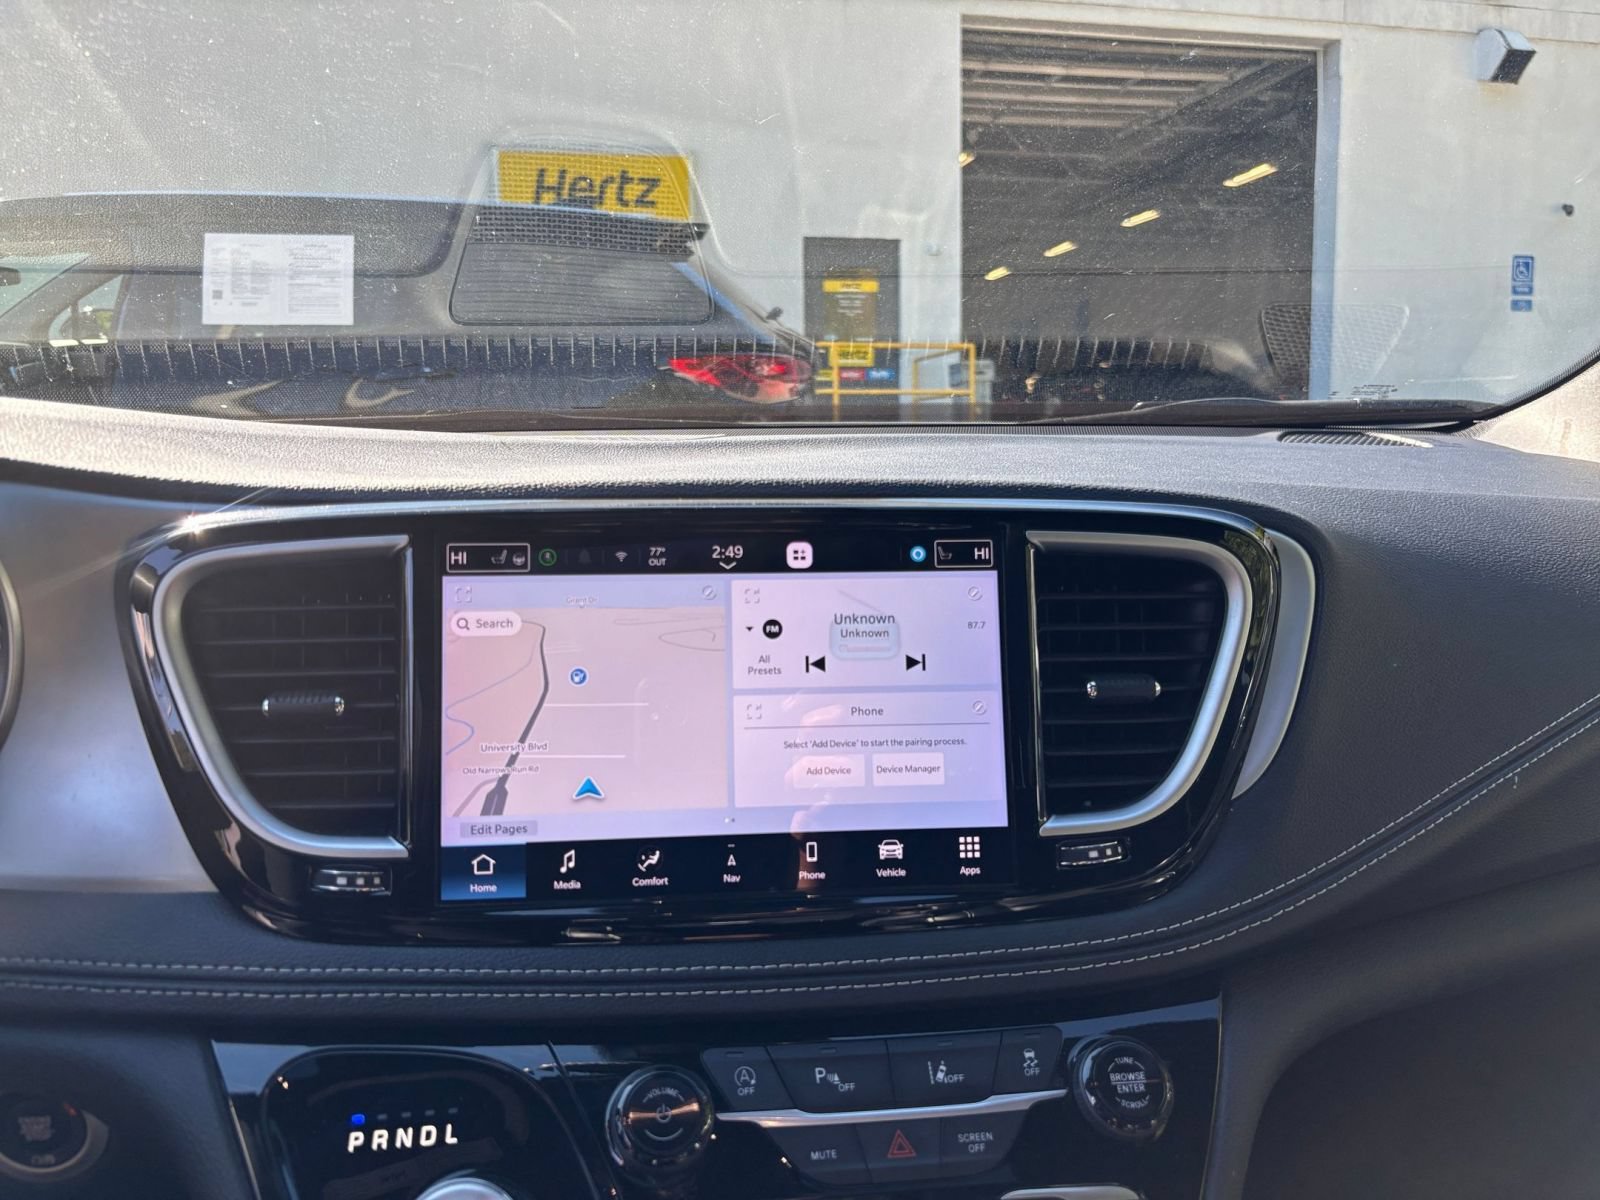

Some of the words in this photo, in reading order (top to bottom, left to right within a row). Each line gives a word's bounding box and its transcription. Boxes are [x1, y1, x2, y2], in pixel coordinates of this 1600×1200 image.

[533, 168, 661, 208] Hertz
[712, 545, 744, 559] 2:49
[974, 547, 989, 560] HI
[451, 552, 467, 565] HI
[648, 558, 667, 567] OUT
[475, 617, 514, 629] Search
[833, 613, 896, 625] Unknown
[765, 625, 779, 633] FM
[967, 621, 986, 629] 87.7
[840, 628, 890, 639] Unknown
[758, 654, 771, 664] All
[747, 666, 782, 676] Presets
[850, 706, 884, 717] Phone
[480, 742, 526, 753] University
[528, 742, 548, 751] Blvd
[783, 740, 808, 749] Select
[860, 739, 869, 748] to
[870, 739, 889, 748] start
[890, 738, 904, 747] the
[905, 738, 933, 749] pairing
[462, 767, 477, 775] Old
[806, 766, 822, 775] Add
[823, 766, 852, 775] Device
[876, 765, 903, 775] Device
[904, 764, 941, 776] Manager
[470, 825, 492, 836] Edit
[494, 823, 528, 837] Pages
[798, 870, 826, 880] Phone
[876, 868, 907, 878] Vehicle
[959, 865, 981, 877] Apps
[632, 876, 669, 887] Comfort
[723, 874, 741, 883] Nav
[469, 884, 498, 894] Home
[553, 879, 581, 890] Media
[1114, 1056, 1135, 1065] TUNE
[815, 1067, 826, 1084] P
[1024, 1067, 1041, 1077] OFF
[1109, 1071, 1146, 1082] BROWSE
[947, 1073, 966, 1084] OFF
[737, 1086, 756, 1096] OFF
[838, 1082, 856, 1092] OFF
[1116, 1083, 1147, 1094] ENTER
[957, 1131, 994, 1144] SCREEN
[967, 1142, 986, 1153] OFF
[810, 1148, 838, 1161] MUTE
